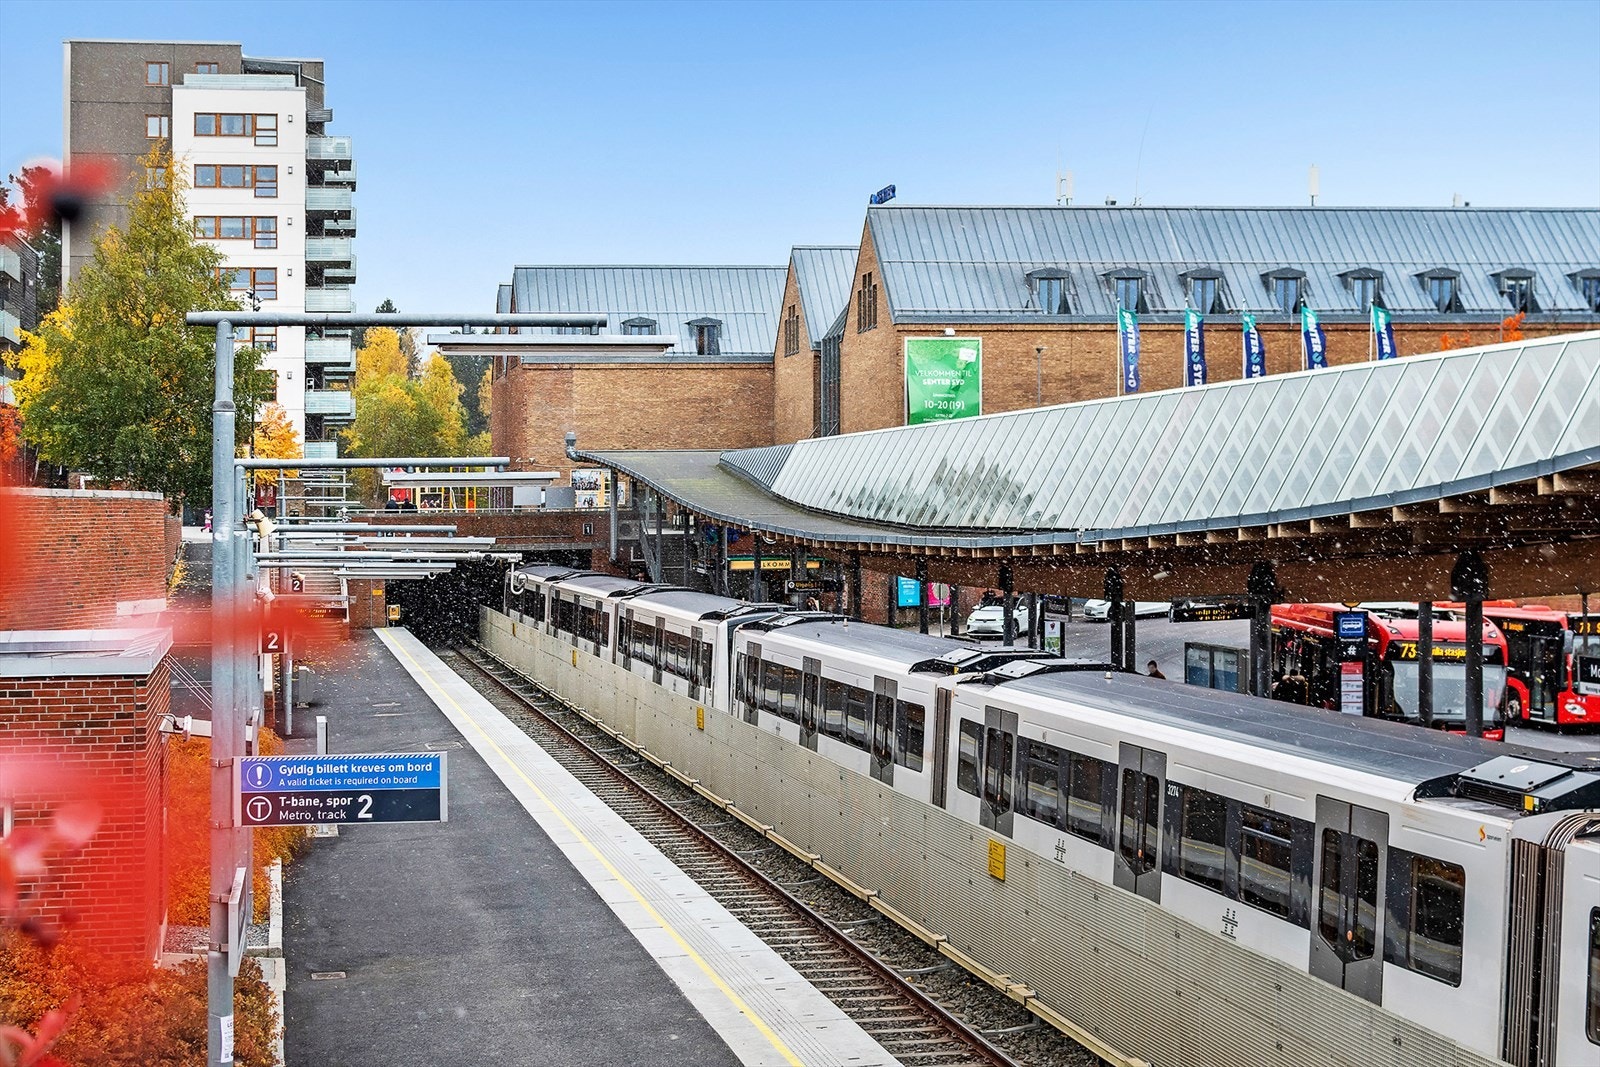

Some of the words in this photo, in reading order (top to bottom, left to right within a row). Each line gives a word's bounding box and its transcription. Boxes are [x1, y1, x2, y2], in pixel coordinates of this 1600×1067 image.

[924, 400, 948, 409] 10-20
[949, 400, 965, 410] (19)
[293, 580, 300, 591] 2
[268, 632, 279, 650] 2
[1401, 643, 1417, 658] 73
[279, 764, 314, 777] Gyldig
[316, 763, 349, 775] billett
[351, 763, 386, 774] kreves
[388, 764, 405, 773] om
[407, 761, 433, 772] bord
[279, 779, 285, 787] A
[287, 778, 307, 786] valid
[309, 777, 332, 786] ticket
[334, 777, 342, 785] is
[343, 777, 378, 786] required
[380, 777, 392, 785] on
[393, 776, 418, 784] board
[279, 796, 323, 808] T-bane,
[326, 797, 354, 809] spor
[357, 794, 374, 819] 2
[279, 811, 315, 822] Metro,
[317, 809, 347, 820] track
